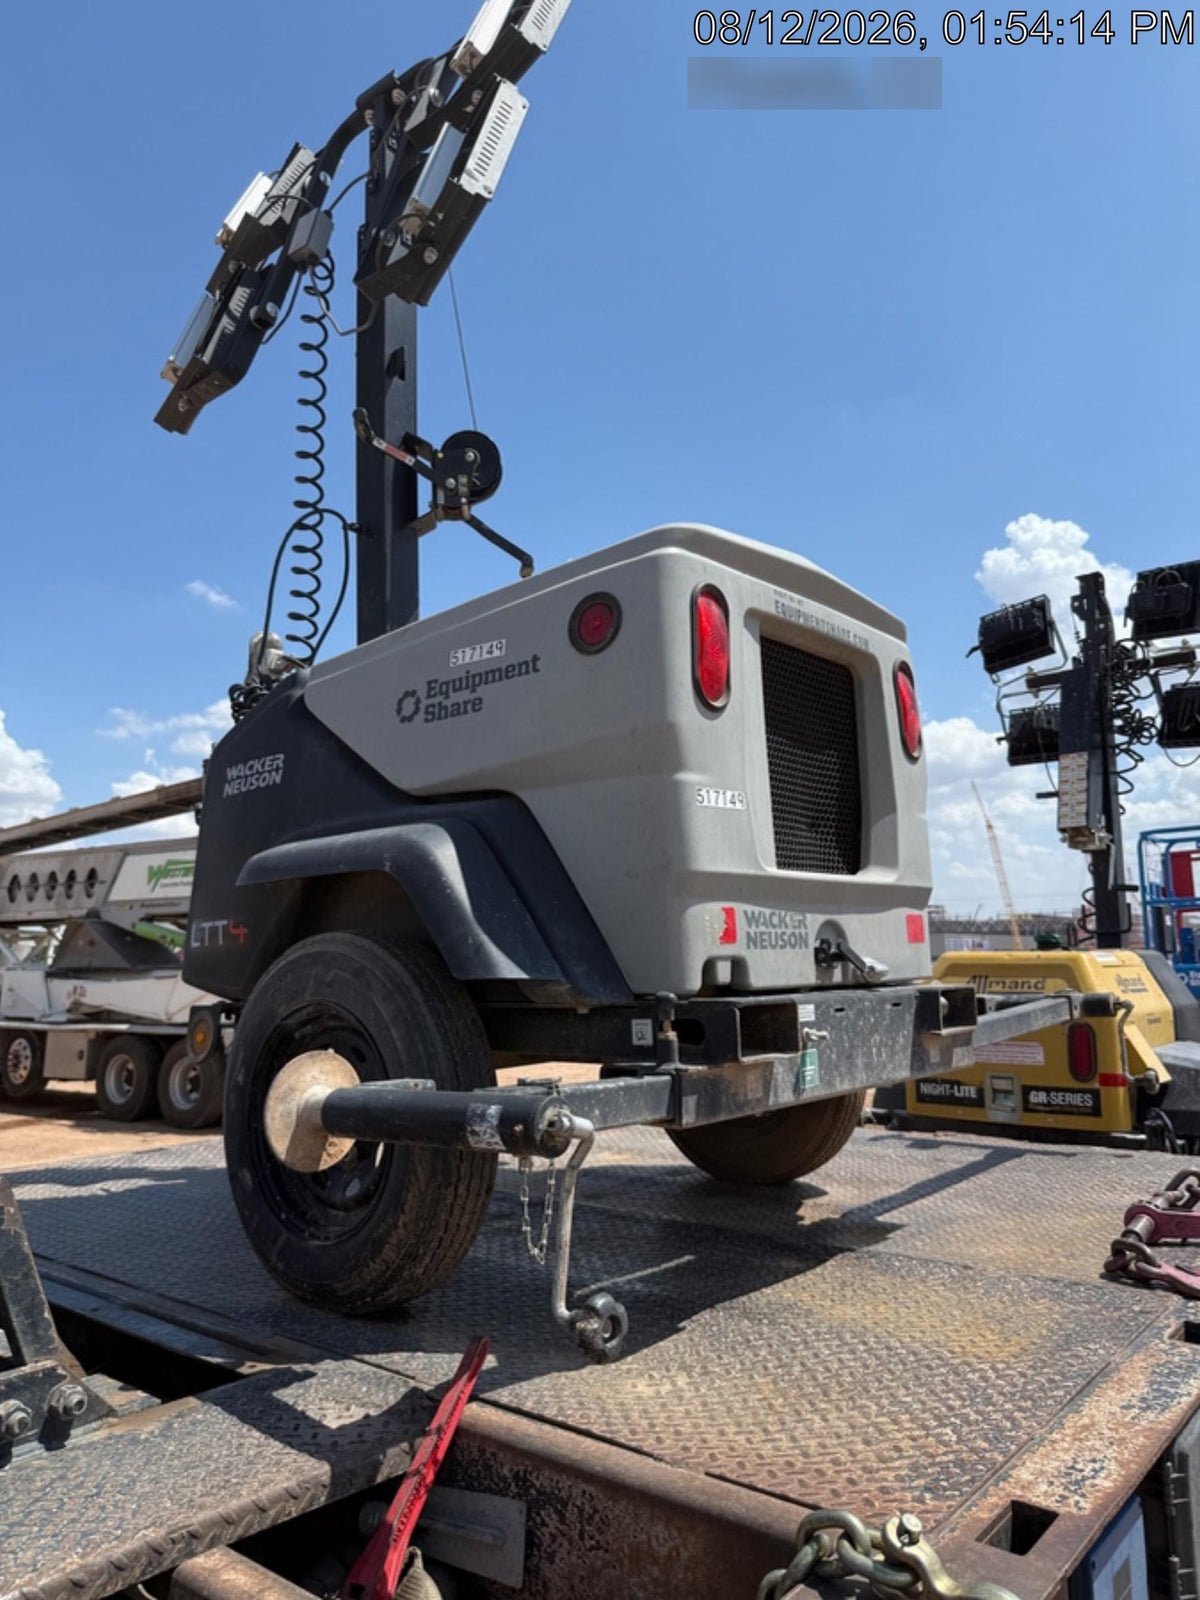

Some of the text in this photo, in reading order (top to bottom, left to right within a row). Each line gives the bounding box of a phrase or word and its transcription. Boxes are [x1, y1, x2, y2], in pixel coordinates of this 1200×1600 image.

[451, 640, 504, 666] 517149
[425, 654, 541, 699] Equipment
[423, 697, 483, 724] Share
[226, 753, 285, 781] WACKER
[223, 769, 283, 797] NEUSON
[697, 788, 745, 809] 517149
[743, 909, 808, 931] WACKER
[746, 929, 809, 950] NEUSON
[966, 975, 1046, 993] Allmand
[920, 1083, 978, 1099] NIGHT-LITE
[1029, 1091, 1093, 1107] GR-SERIES
